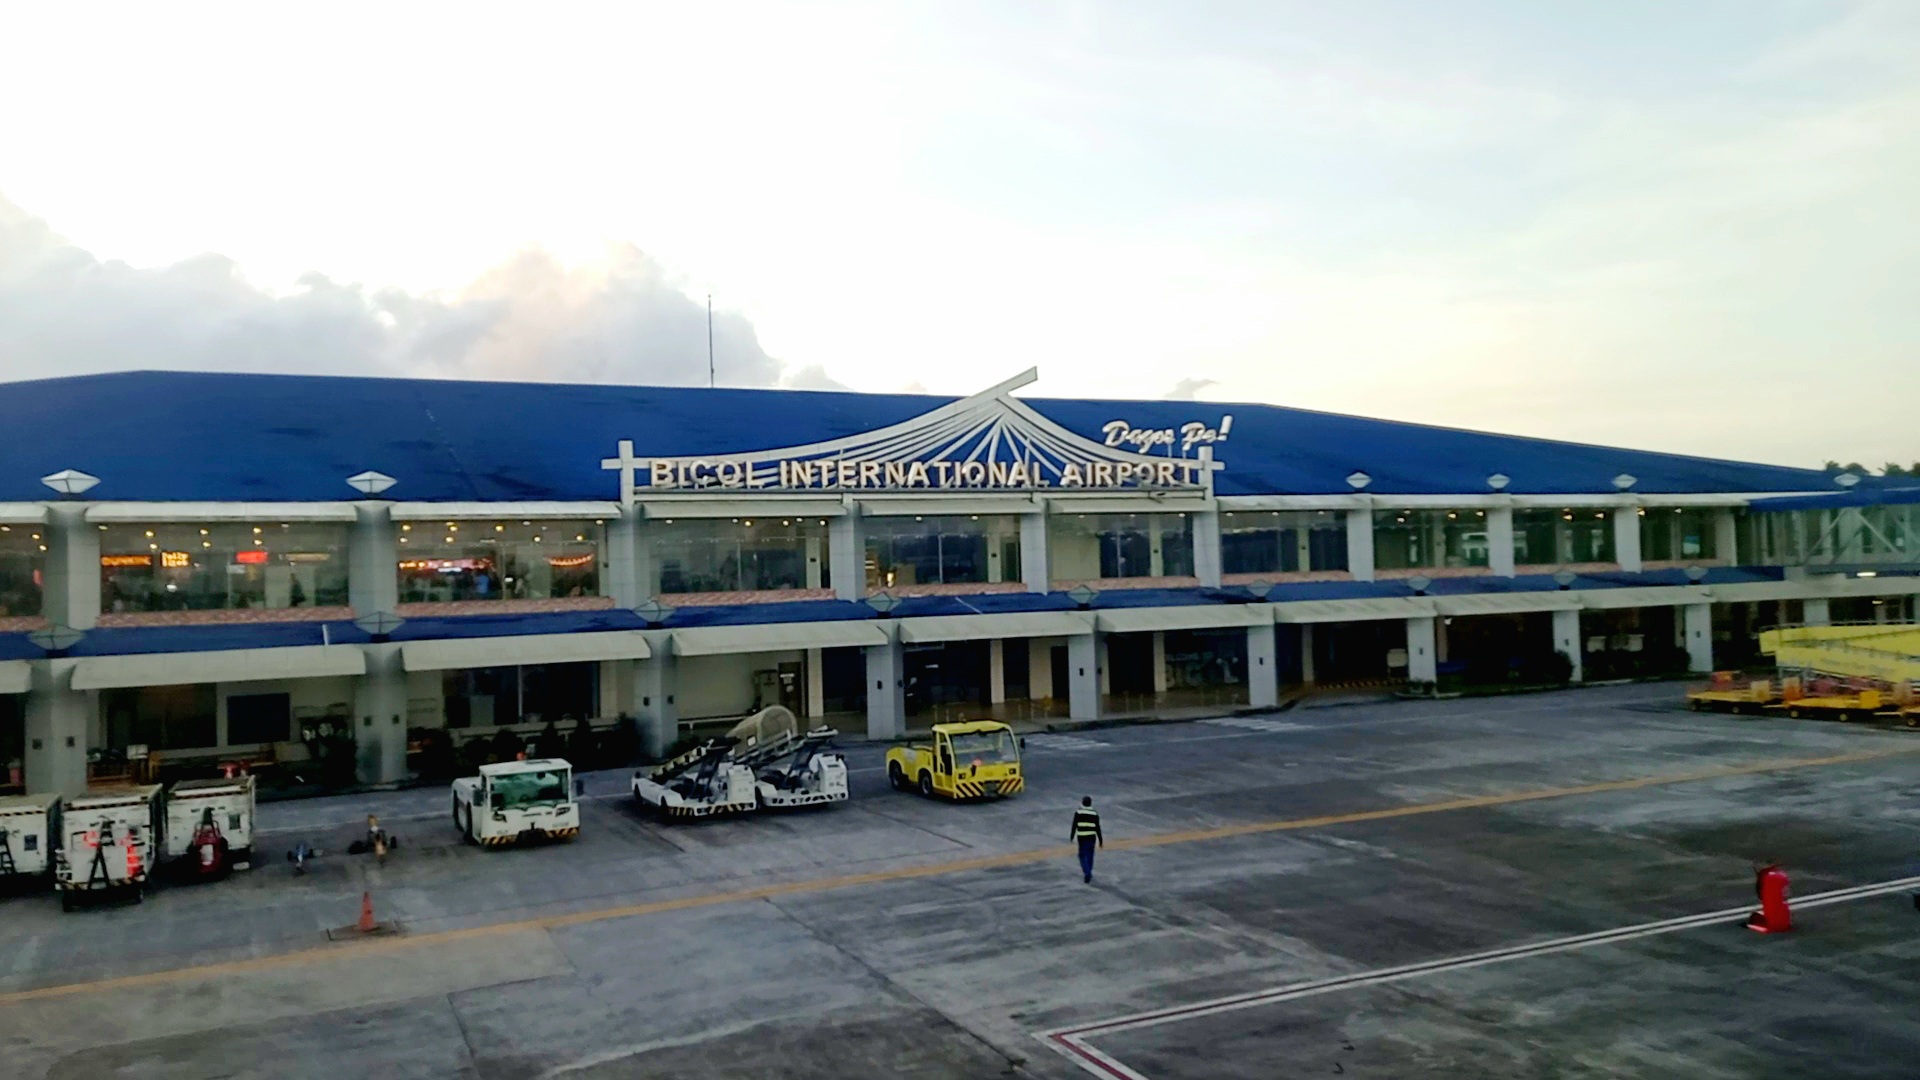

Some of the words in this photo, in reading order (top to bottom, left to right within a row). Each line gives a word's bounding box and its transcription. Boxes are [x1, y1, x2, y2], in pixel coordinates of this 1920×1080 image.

[650, 459, 766, 487] BICOL
[779, 460, 1050, 487] INTERNATIONAL
[1059, 461, 1193, 487] AIRPORT
